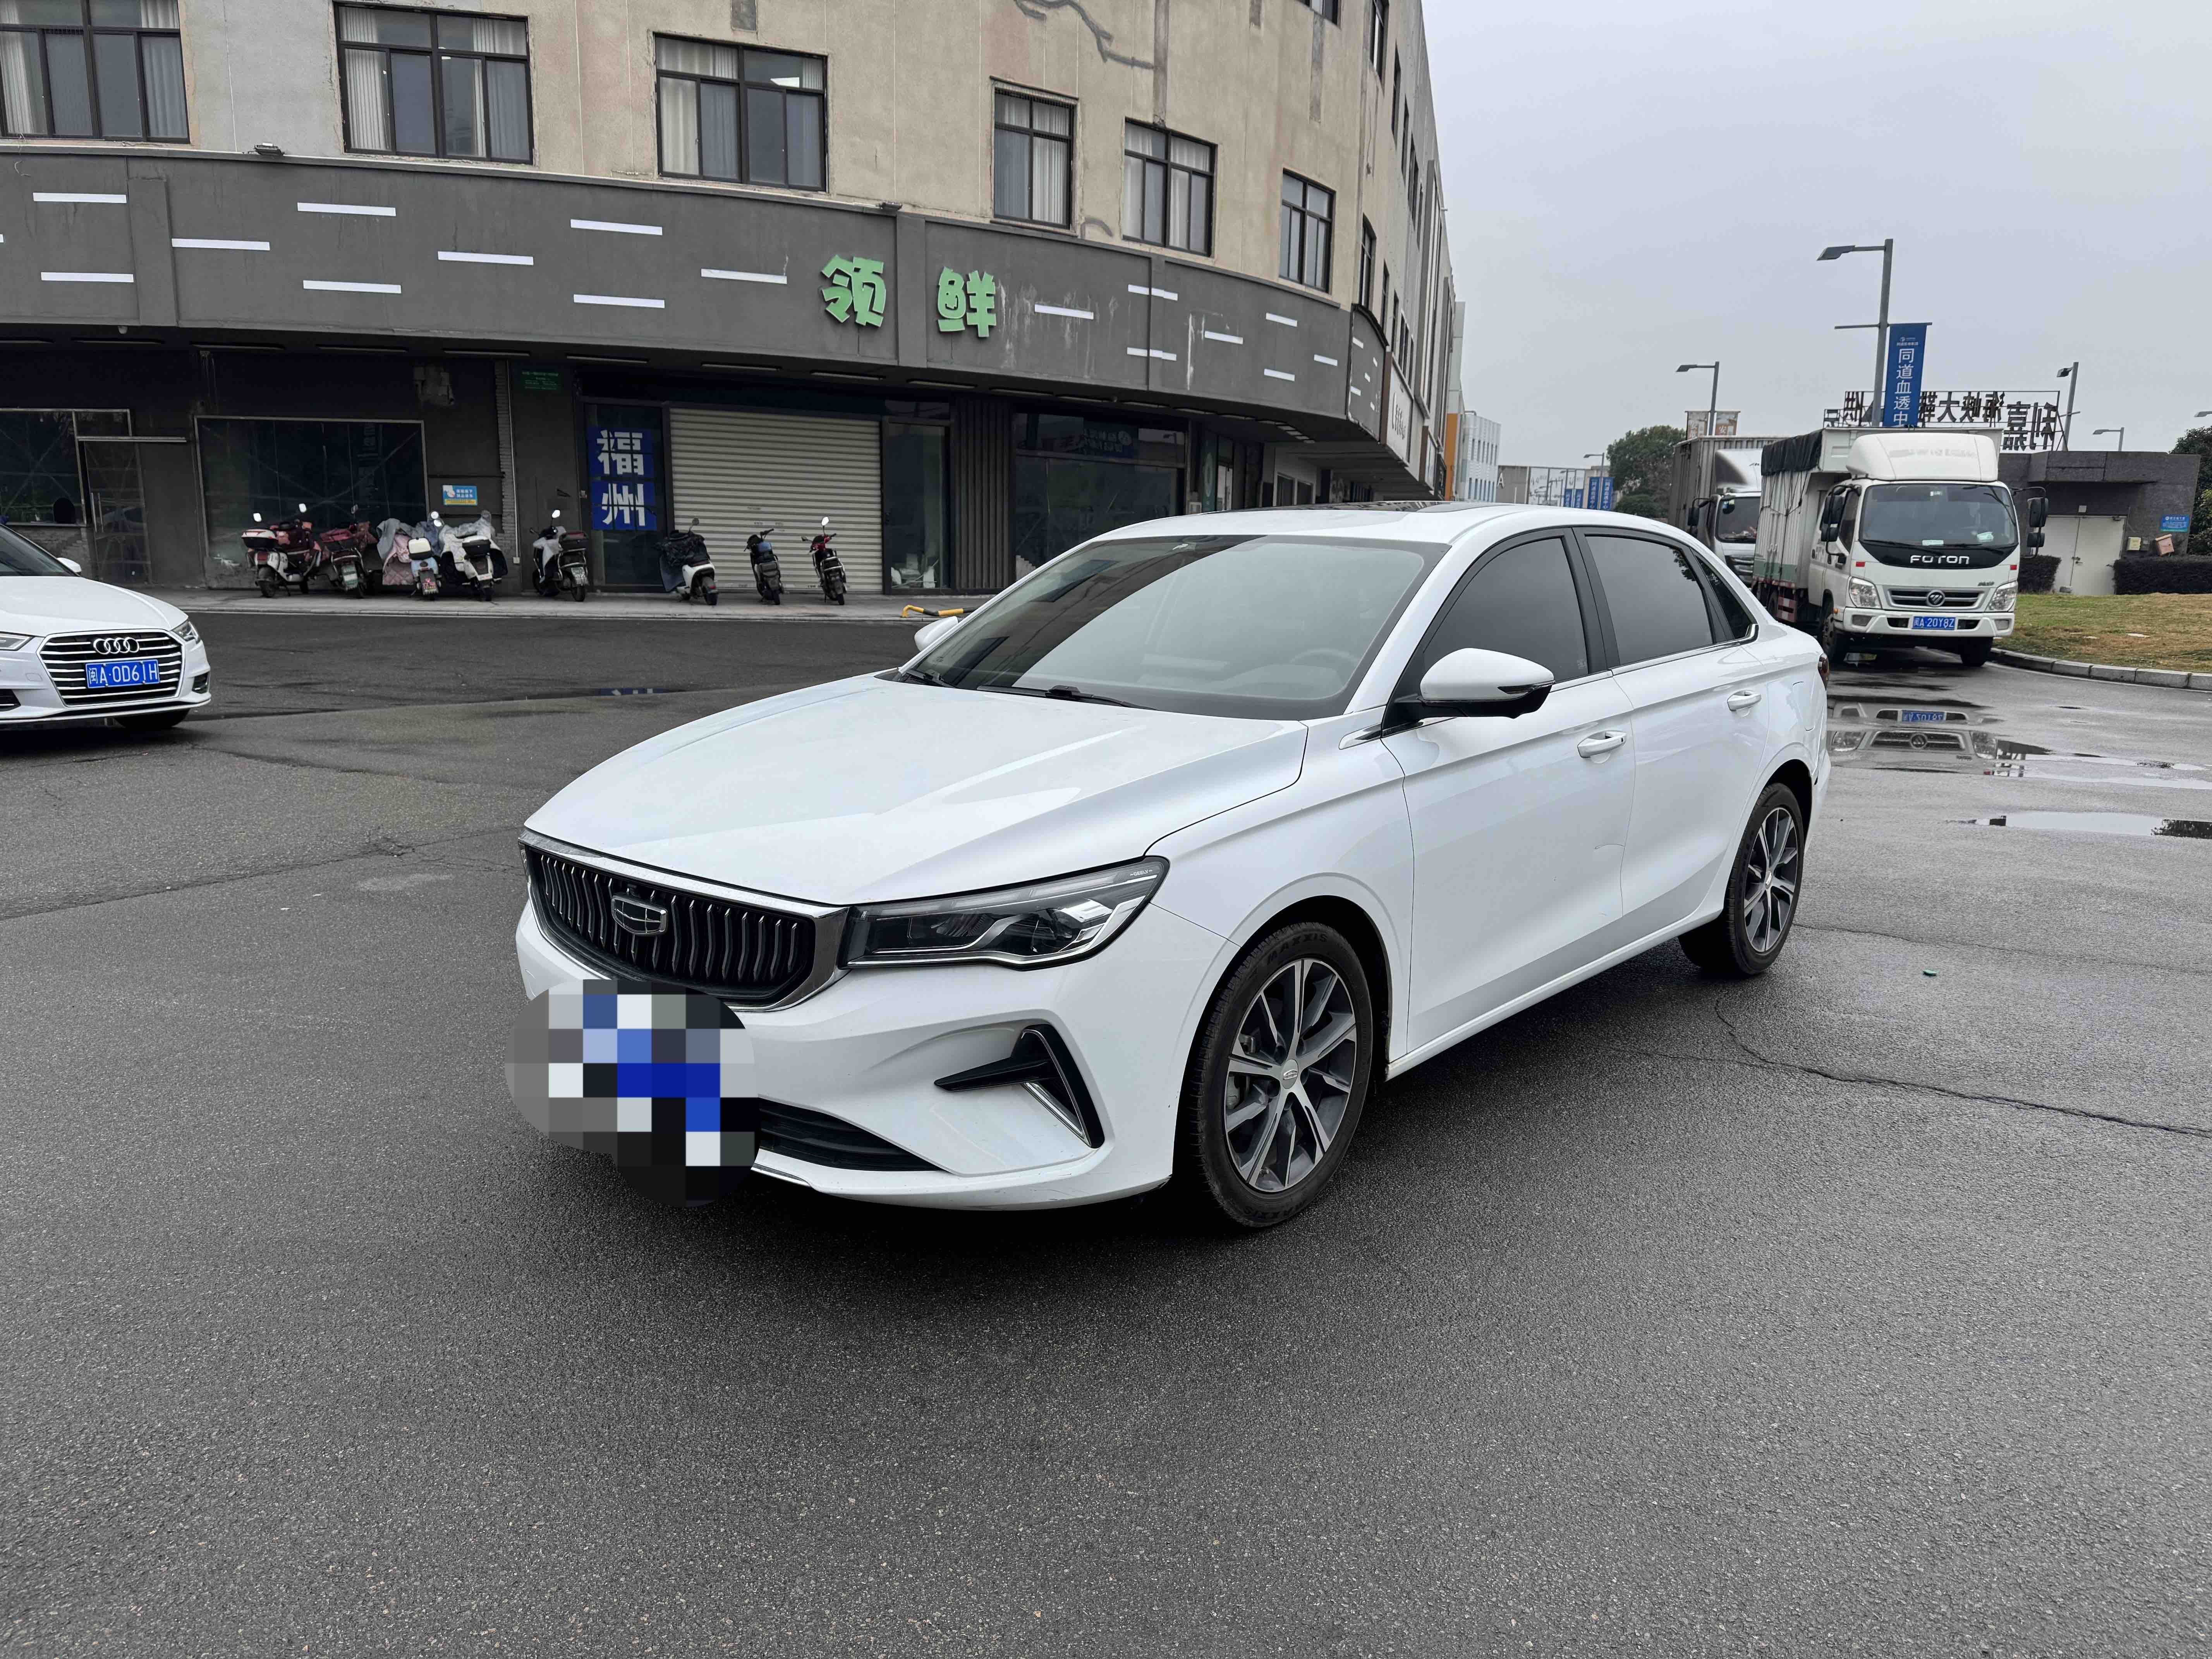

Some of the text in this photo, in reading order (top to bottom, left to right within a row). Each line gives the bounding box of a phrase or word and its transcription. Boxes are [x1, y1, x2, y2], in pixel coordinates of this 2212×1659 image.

[596, 429, 646, 527] 福州
[1497, 472, 1505, 489] A
[1910, 555, 1970, 565] FOTON
[1267, 933, 1328, 966] MAXXIS
